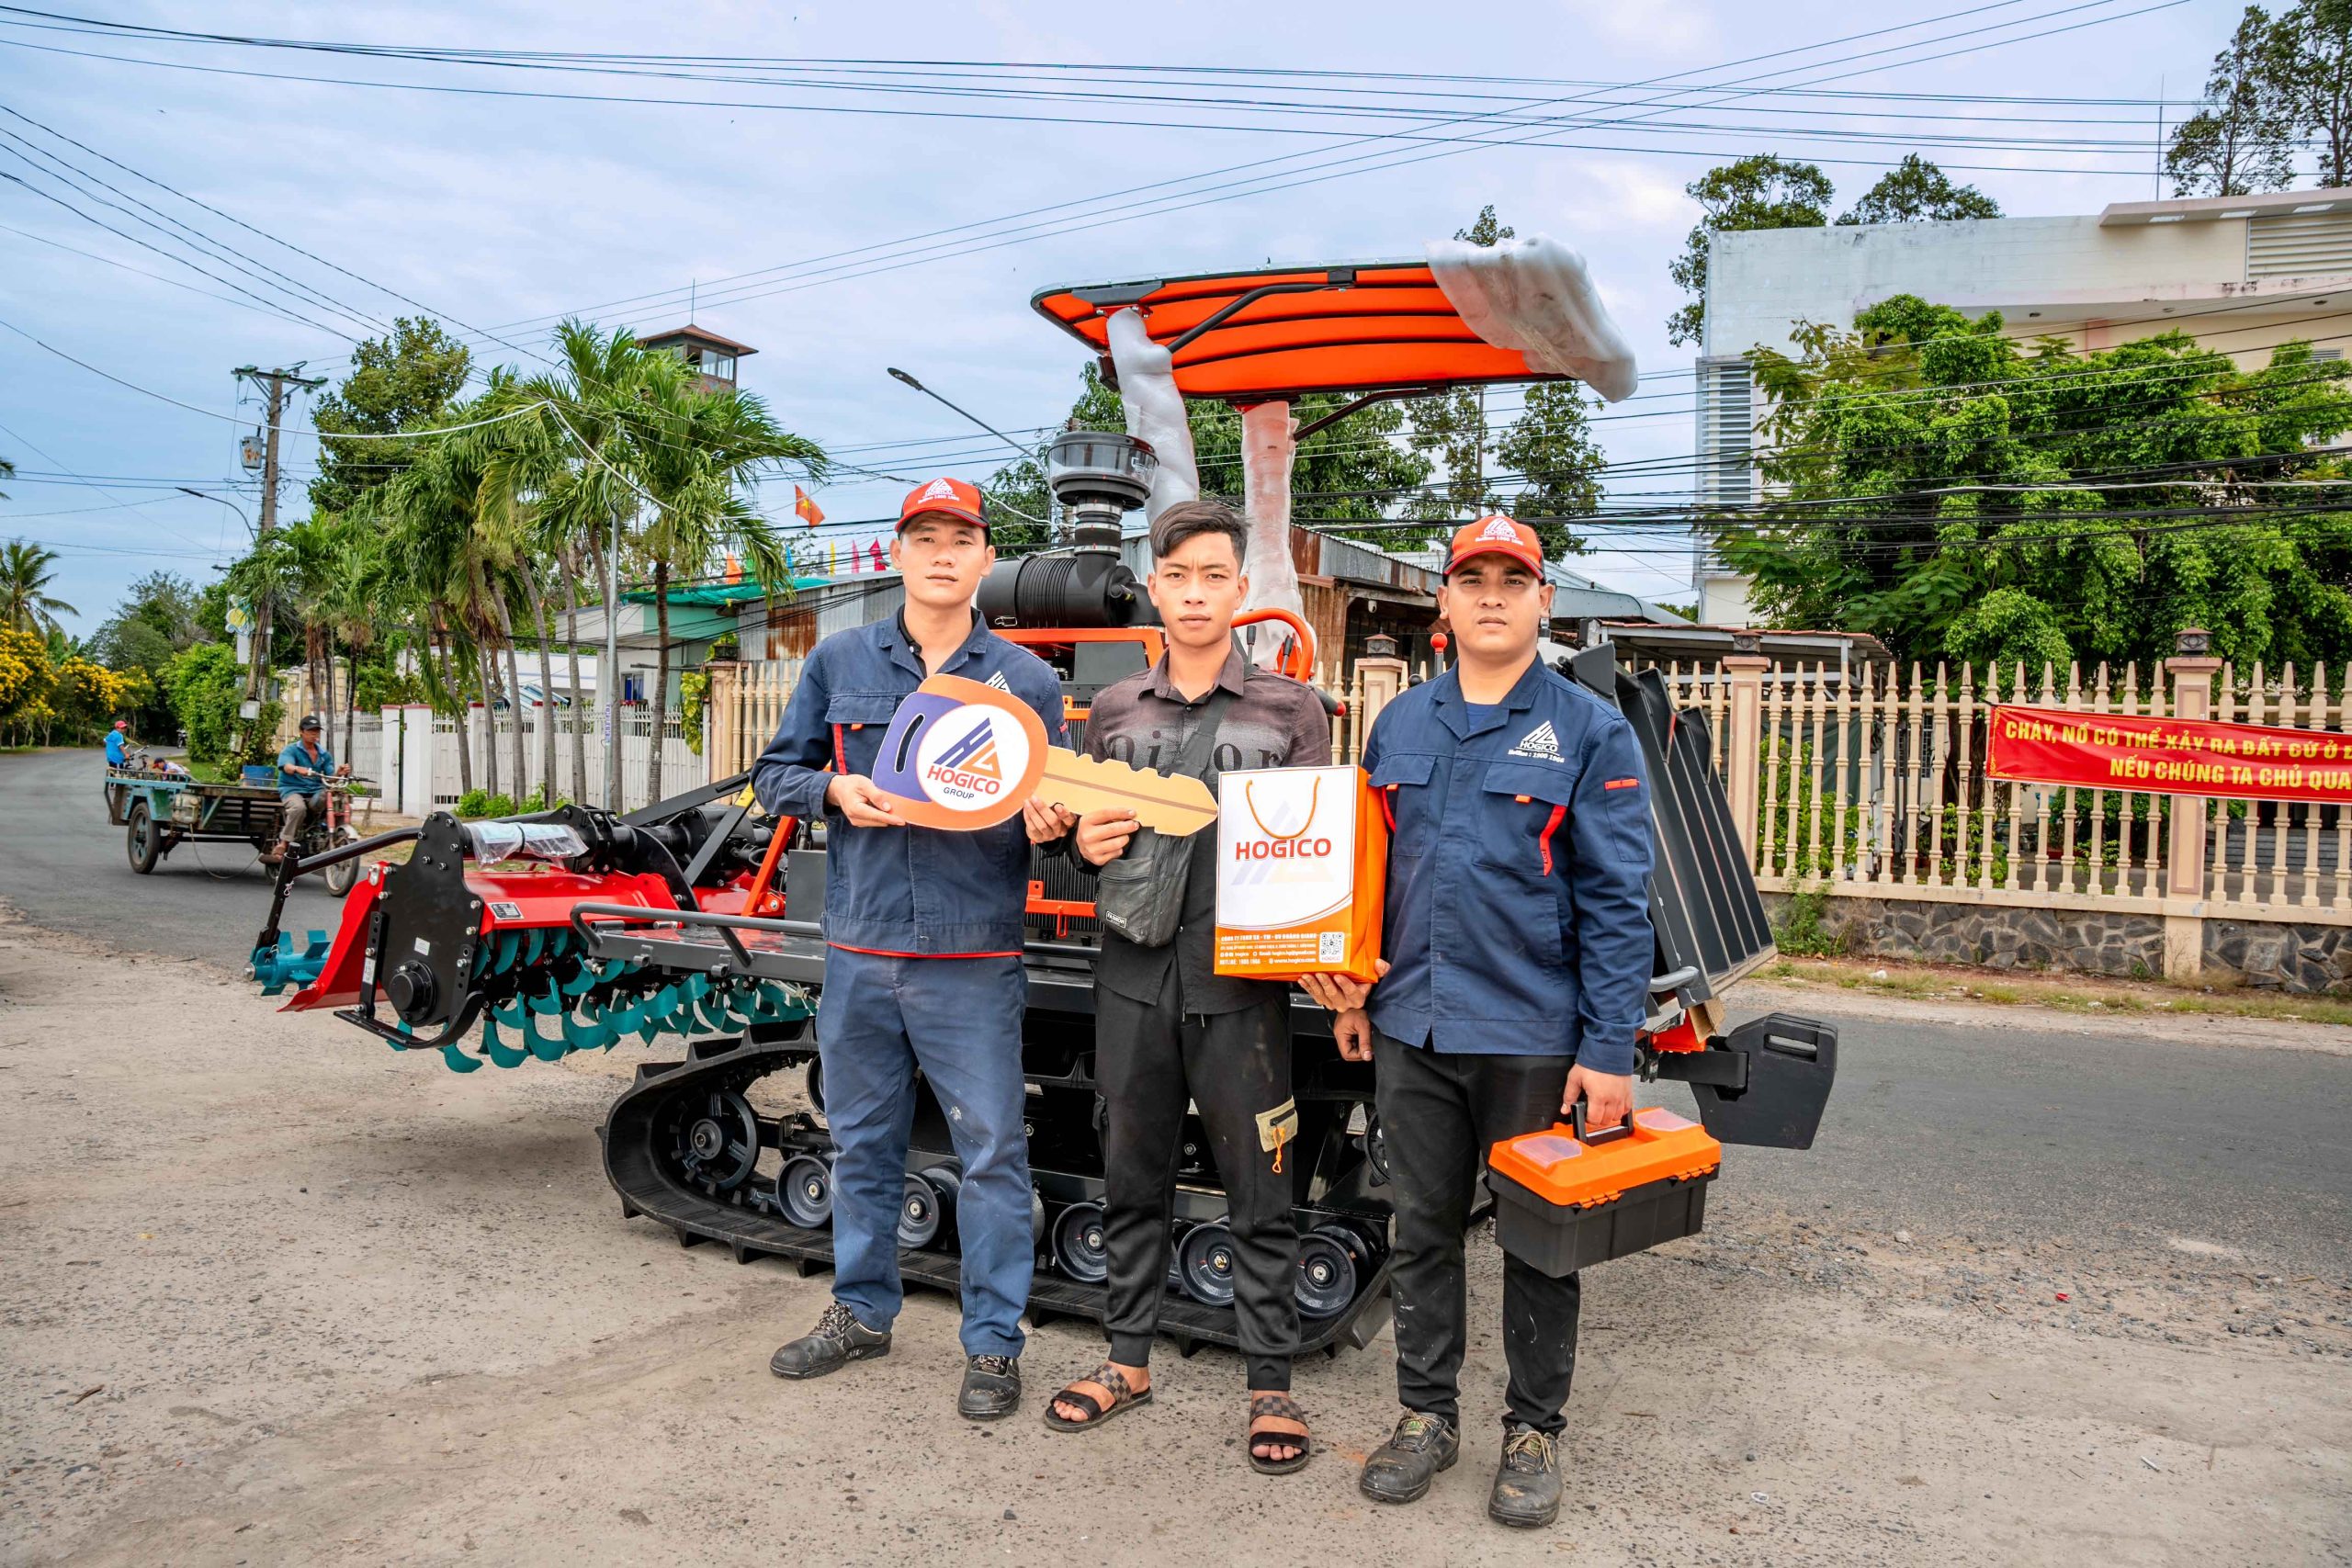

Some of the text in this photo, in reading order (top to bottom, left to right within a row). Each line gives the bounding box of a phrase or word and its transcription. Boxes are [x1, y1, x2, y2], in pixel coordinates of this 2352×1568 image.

[1520, 740, 1558, 752] HOGICO
[2006, 720, 2057, 744] CHÁY,
[2062, 721, 2090, 744] NỔ
[2093, 727, 2119, 746] CÓ
[2123, 727, 2162, 750] THỂ
[2165, 729, 2205, 751] XẢY
[2210, 738, 2236, 755] RA
[2288, 740, 2320, 759] CỨ
[2324, 739, 2338, 760] Ở
[926, 765, 1001, 795] HOGICO
[2109, 754, 2352, 791] NẾU CHÚNG TA CHỦ QUA
[943, 786, 975, 799] GROUP
[1236, 838, 1331, 860] HOGICO
